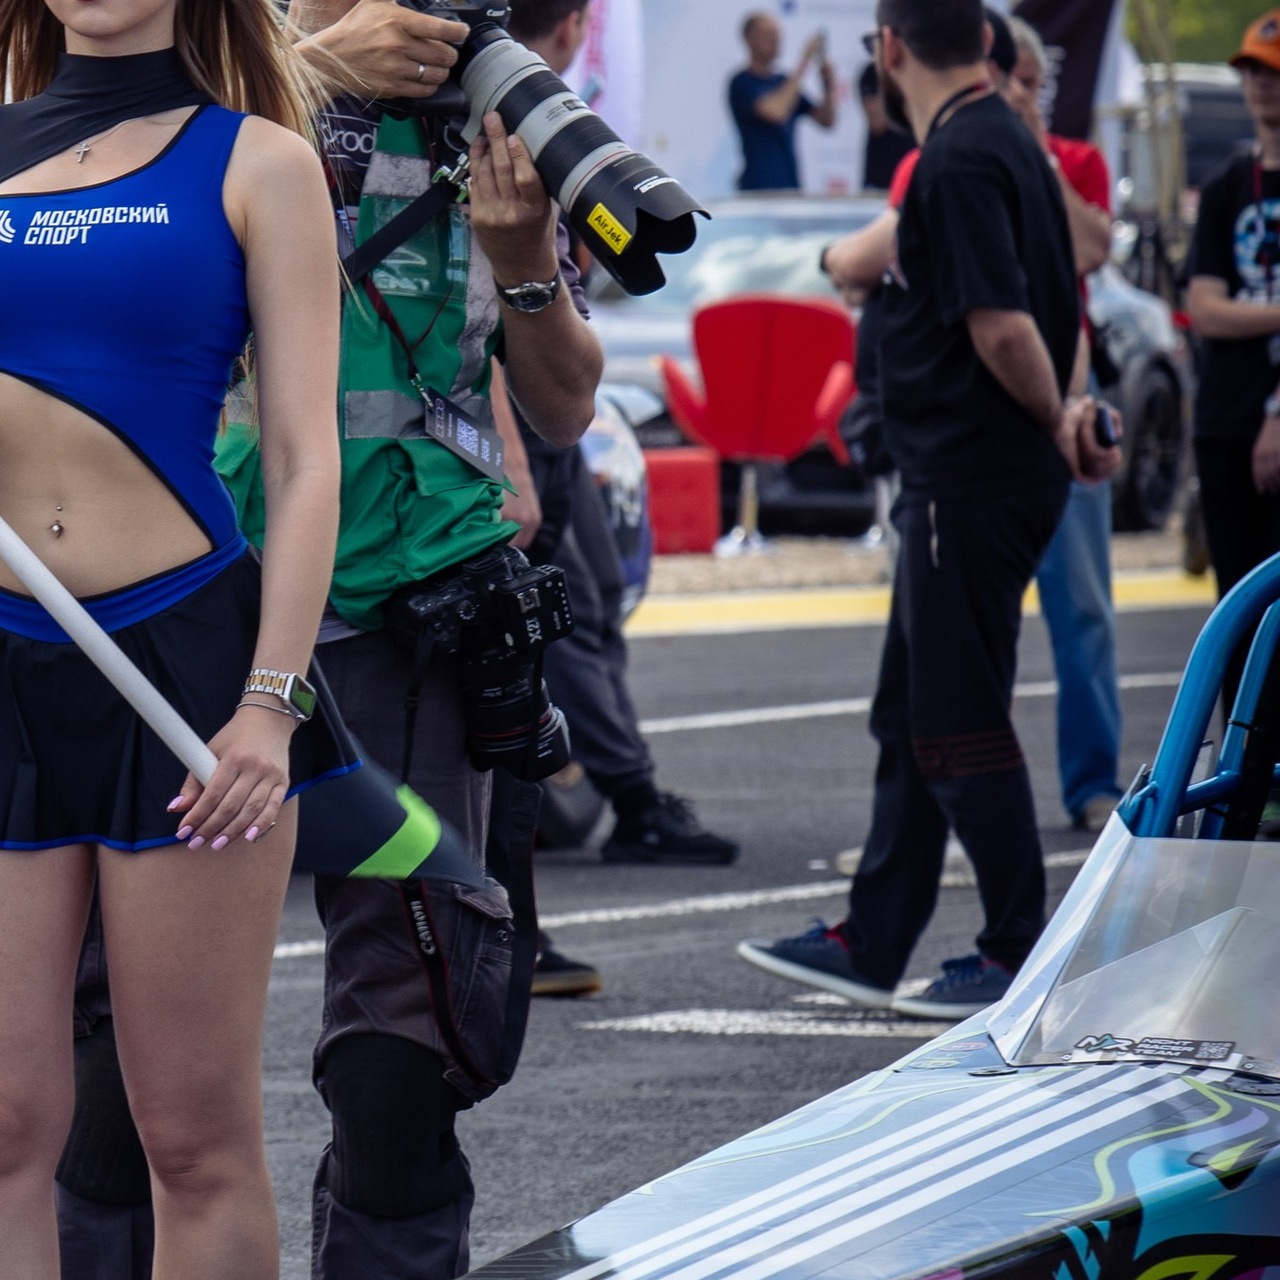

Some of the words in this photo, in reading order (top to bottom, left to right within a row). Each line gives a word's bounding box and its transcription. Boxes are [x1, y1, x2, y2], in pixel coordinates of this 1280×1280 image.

[30, 204, 169, 227] МОСКОВСКИЙ
[23, 225, 92, 245] СПОРТ
[410, 900, 436, 955] Canon
[1133, 1048, 1182, 1058] TEAM
[1137, 1043, 1196, 1052] RACER
